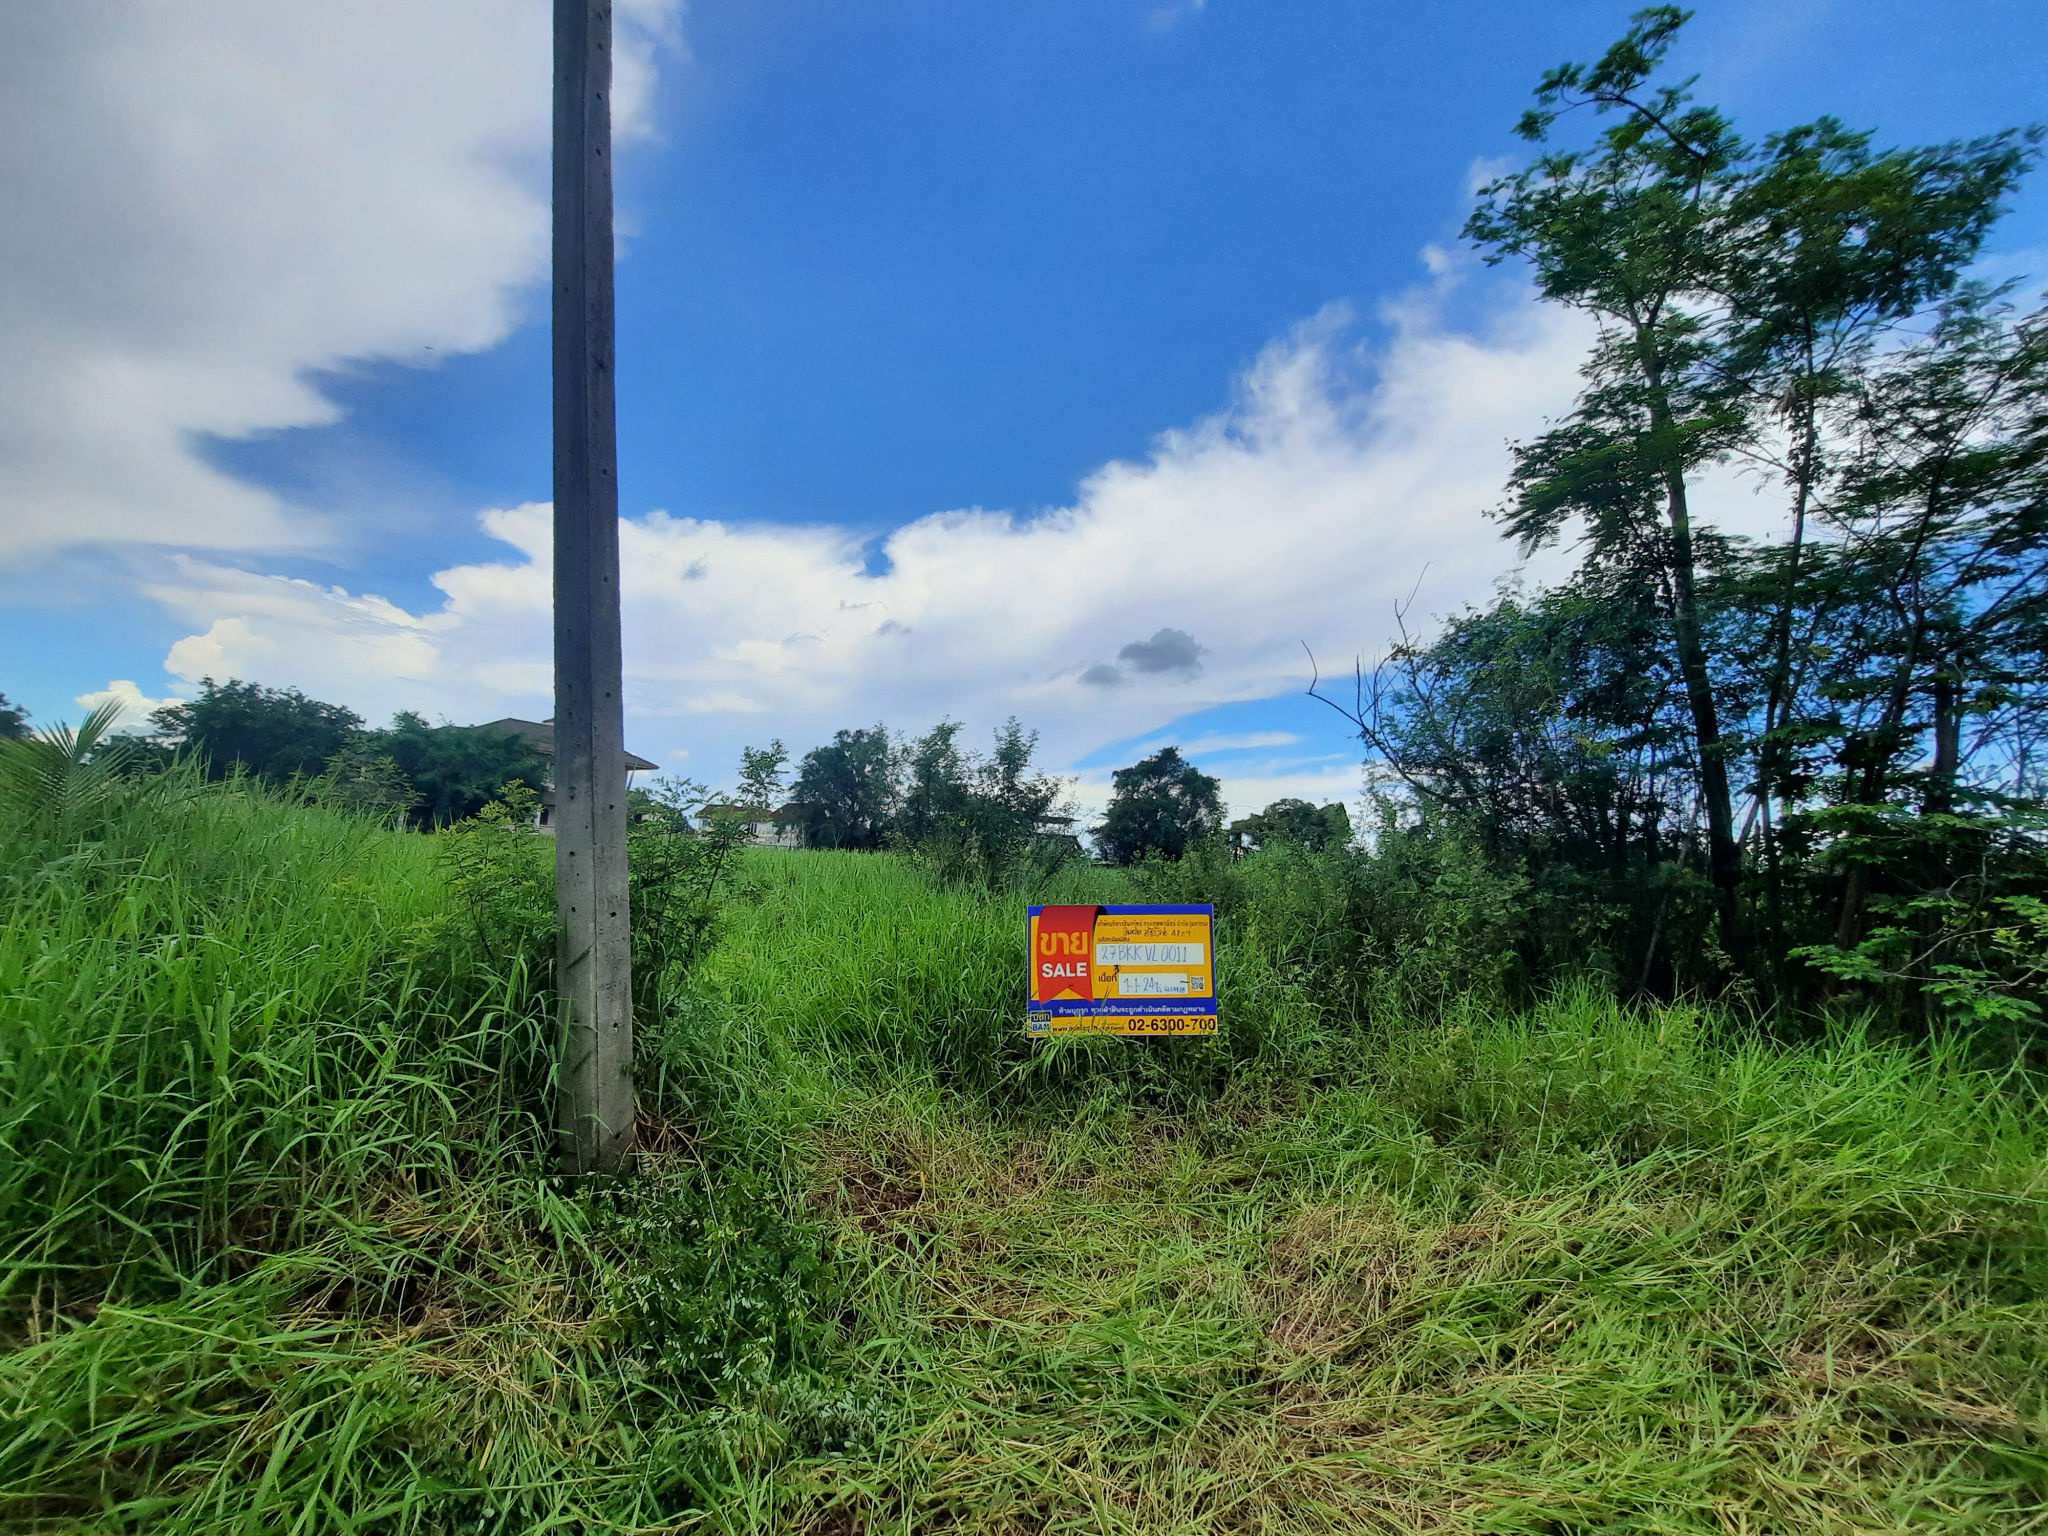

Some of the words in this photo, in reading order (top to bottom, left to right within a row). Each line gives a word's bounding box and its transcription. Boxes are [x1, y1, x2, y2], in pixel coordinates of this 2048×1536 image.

[1040, 931, 1088, 956] ขาย
[1041, 962, 1088, 978] SALE
[1128, 1018, 1216, 1031] 02-6300-700
